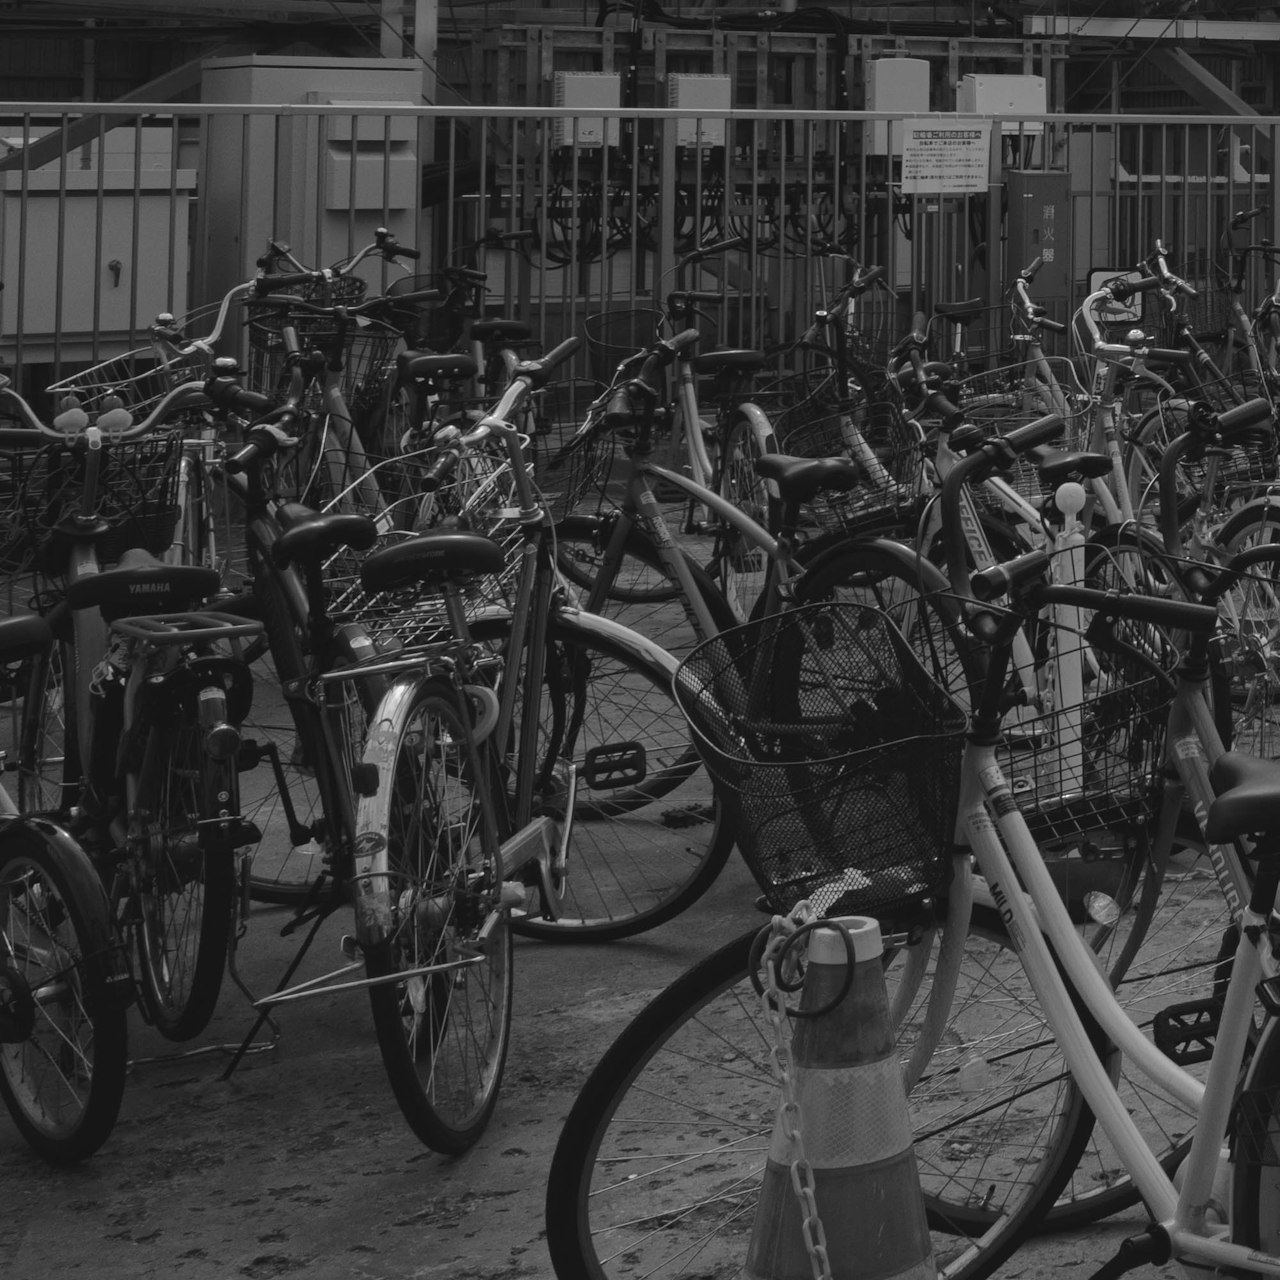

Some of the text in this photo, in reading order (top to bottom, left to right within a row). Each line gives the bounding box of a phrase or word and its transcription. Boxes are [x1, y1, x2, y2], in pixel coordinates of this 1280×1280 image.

[1042, 204, 1055, 262] 消火器
[128, 582, 170, 594] YAMAHA
[990, 882, 1013, 924] MILD
